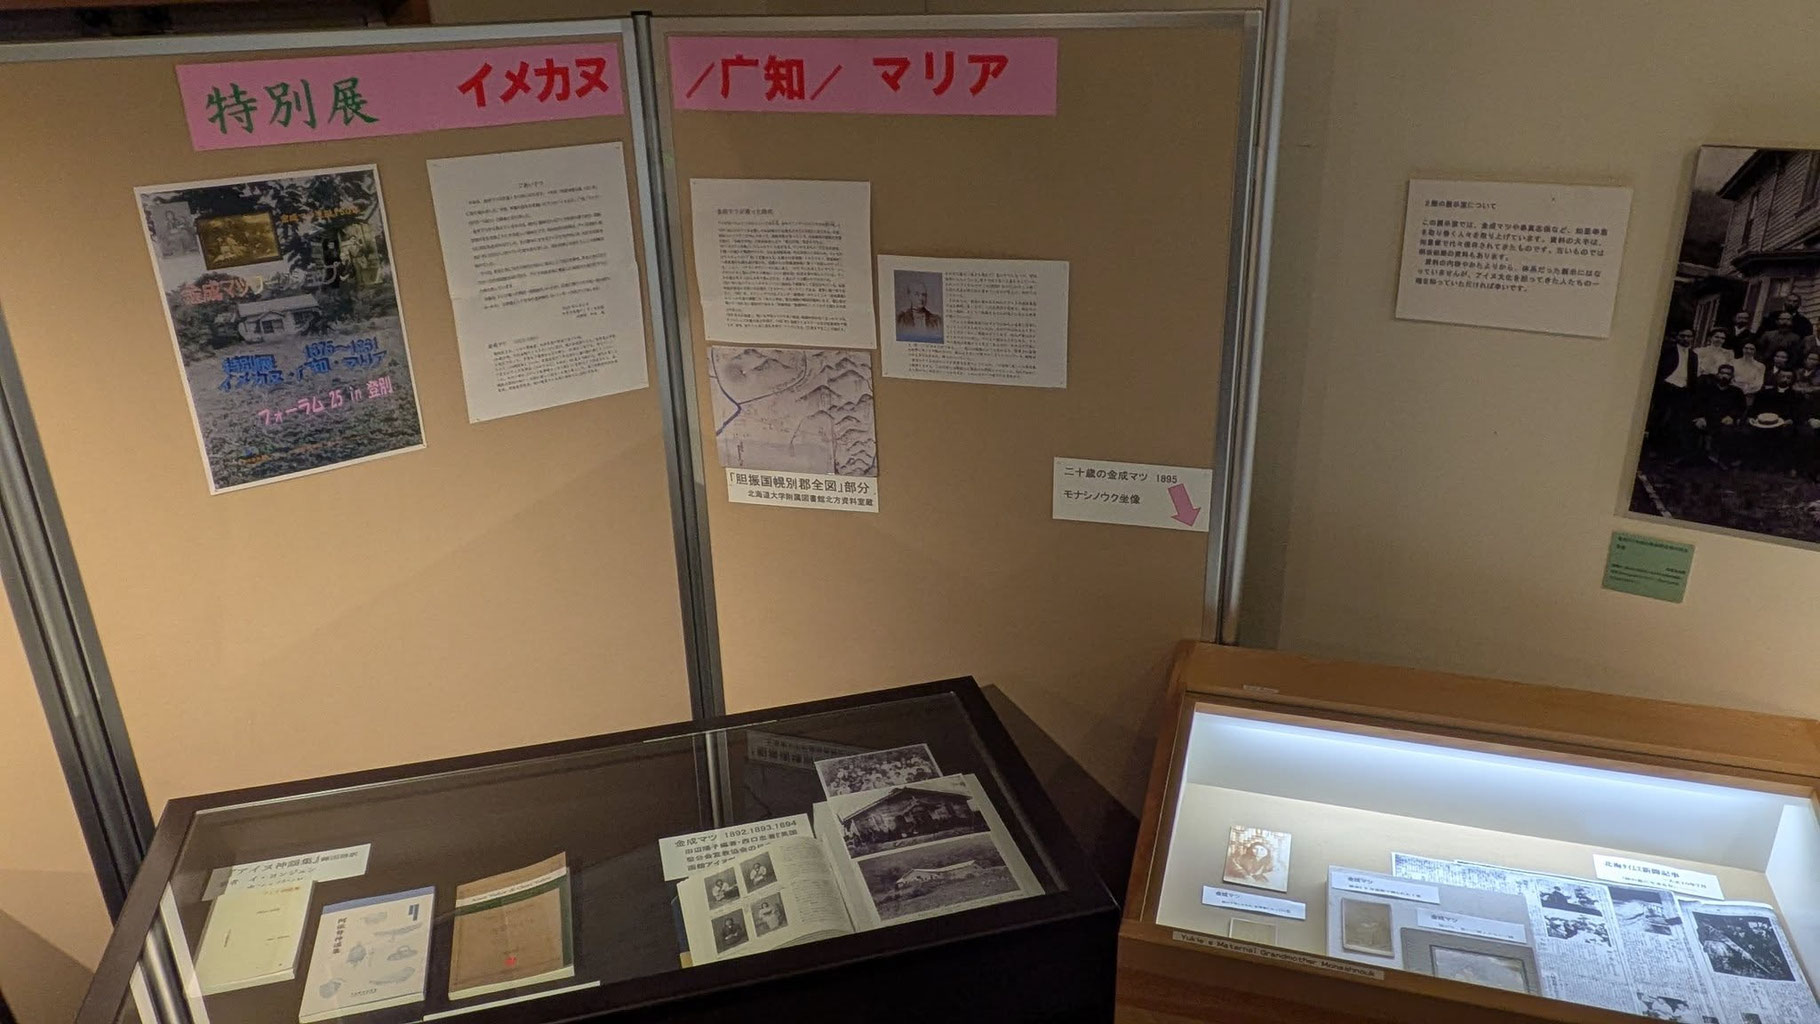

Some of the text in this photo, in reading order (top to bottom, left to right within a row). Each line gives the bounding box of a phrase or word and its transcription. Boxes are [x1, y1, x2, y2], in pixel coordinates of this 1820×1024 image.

[873, 51, 1008, 95] マリア
[205, 56, 609, 136] 特別展 イメカヌ
[258, 376, 392, 425] フォーラム 25 in 登別
[1064, 467, 1177, 484] 二十歳の金成マツ 1895
[674, 834, 718, 849] 金成マツ
